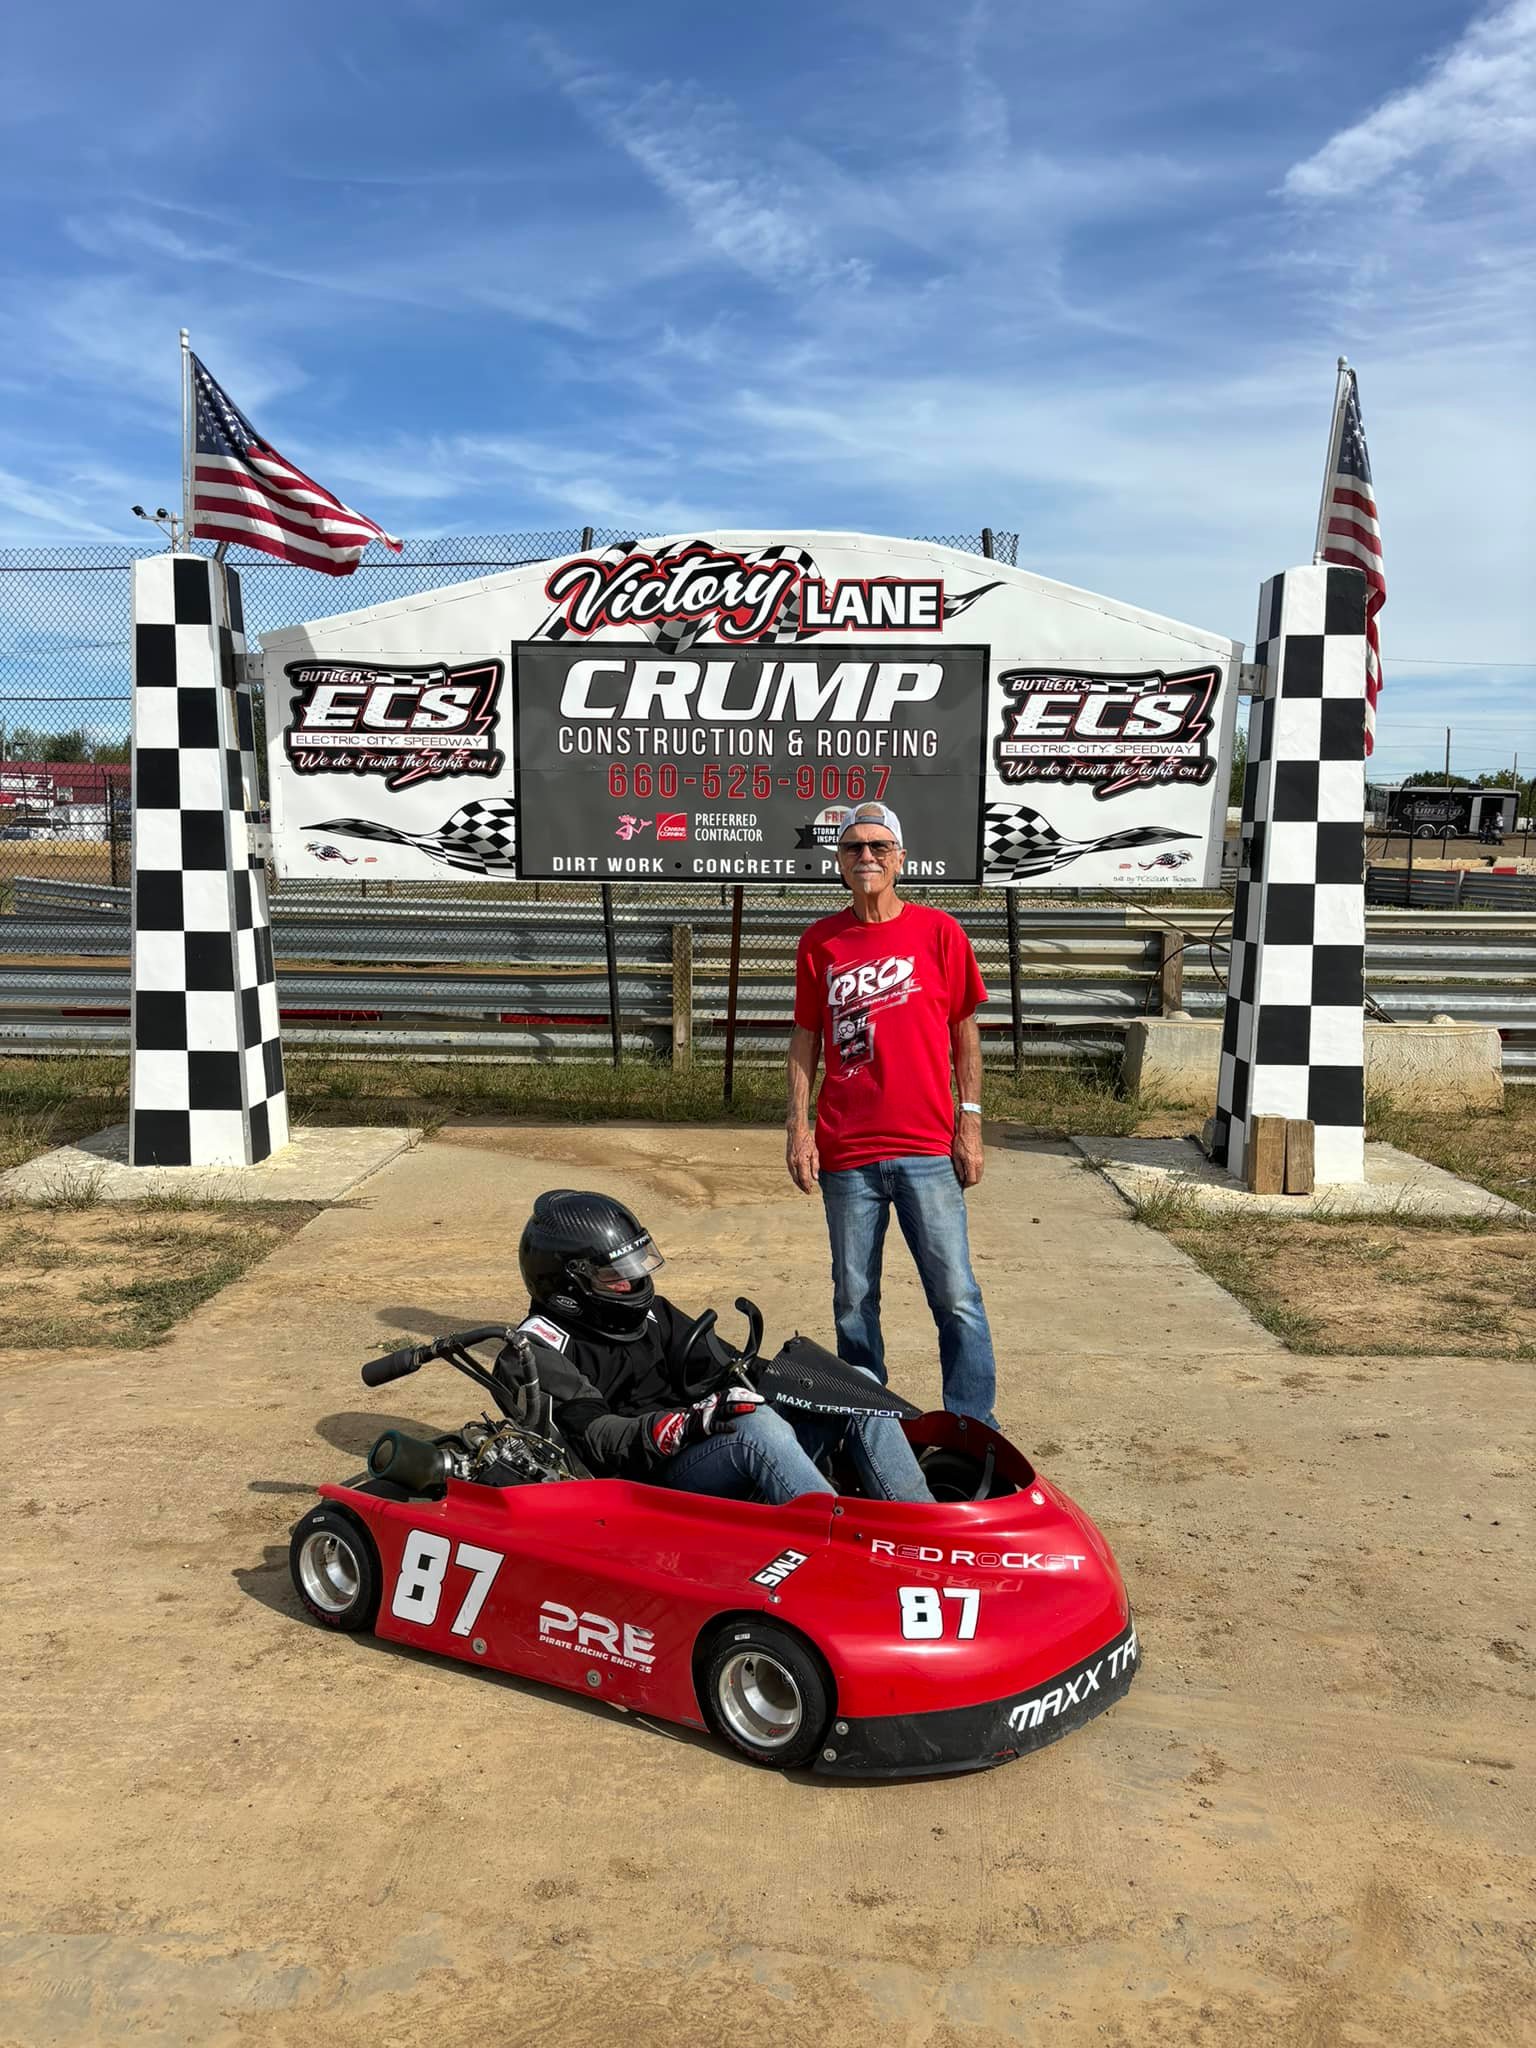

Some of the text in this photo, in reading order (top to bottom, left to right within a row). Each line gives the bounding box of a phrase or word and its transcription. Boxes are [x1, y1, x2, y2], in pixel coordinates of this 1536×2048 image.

[551, 554, 940, 637] Victory LANE
[299, 671, 377, 684] BUTLER'S
[559, 659, 944, 723] CRUMP
[1012, 679, 1092, 692] BUTLER'S
[301, 685, 480, 730] ECS
[1012, 693, 1194, 738] ECS
[403, 738, 483, 748] SPEEDWAY
[558, 726, 938, 758] CONSTRUCTION & ROOFING
[1114, 744, 1194, 755] SPEEDWAY
[295, 751, 329, 768] We
[332, 752, 351, 767] do
[356, 753, 370, 769] it
[370, 754, 399, 770] with
[402, 753, 424, 770] the
[428, 753, 464, 773] lights
[1004, 760, 1037, 777] We
[1041, 761, 1060, 776] do
[1065, 762, 1079, 777] it
[1078, 763, 1110, 779] with
[1111, 760, 1136, 778] the
[1138, 761, 1174, 782] lights
[607, 762, 893, 801] 660-525-9067
[695, 813, 757, 826] PREFERRED
[813, 826, 836, 835] STORM
[695, 828, 764, 843] CONTRACTOR
[553, 857, 598, 872] DIRT
[607, 857, 665, 873] WORK
[693, 858, 797, 875] CONCRETE
[608, 1244, 634, 1260] MAXX
[776, 1392, 904, 1419] MAXX TRACTION
[871, 1539, 1086, 1571] RED ROCKET
[391, 1528, 505, 1638] 87
[898, 1585, 981, 1640] 87
[539, 1600, 656, 1665] PRE
[539, 1634, 572, 1650] PIRATE
[574, 1644, 609, 1661] RACING
[1007, 1659, 1104, 1732] MAXX
